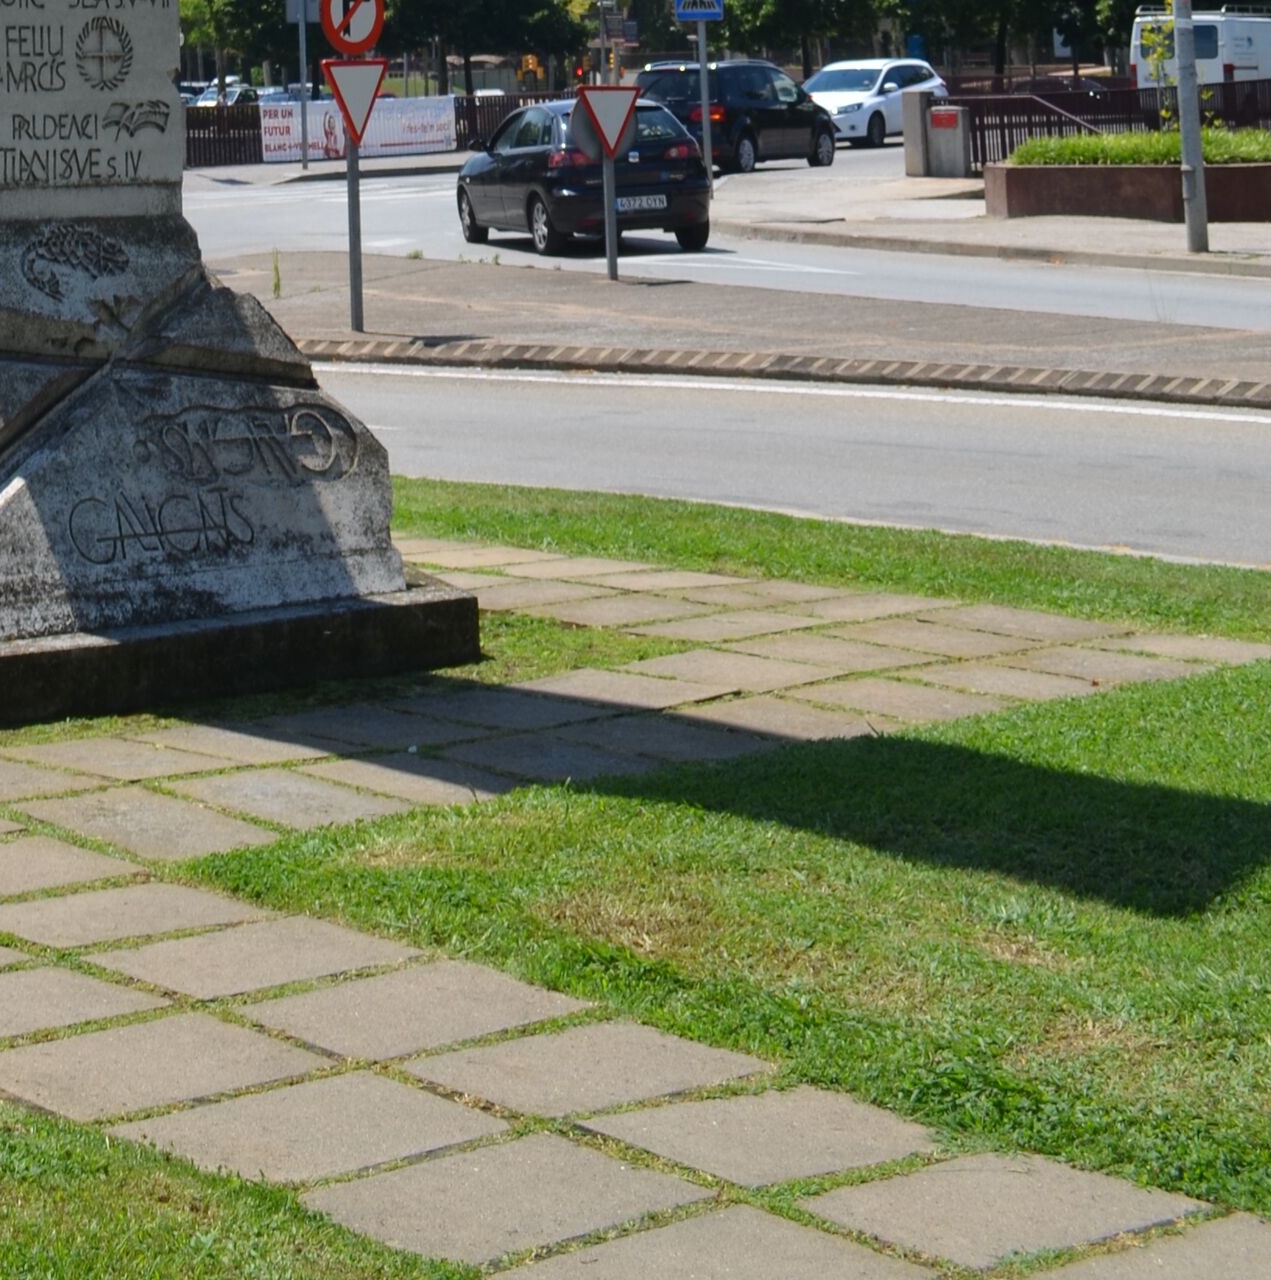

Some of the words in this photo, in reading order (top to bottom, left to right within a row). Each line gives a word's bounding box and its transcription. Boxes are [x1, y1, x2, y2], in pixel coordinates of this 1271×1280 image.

[4, 25, 65, 58] FELIU
[263, 109, 279, 120] PER
[280, 108, 294, 120] UN
[263, 124, 291, 137] FUTUR
